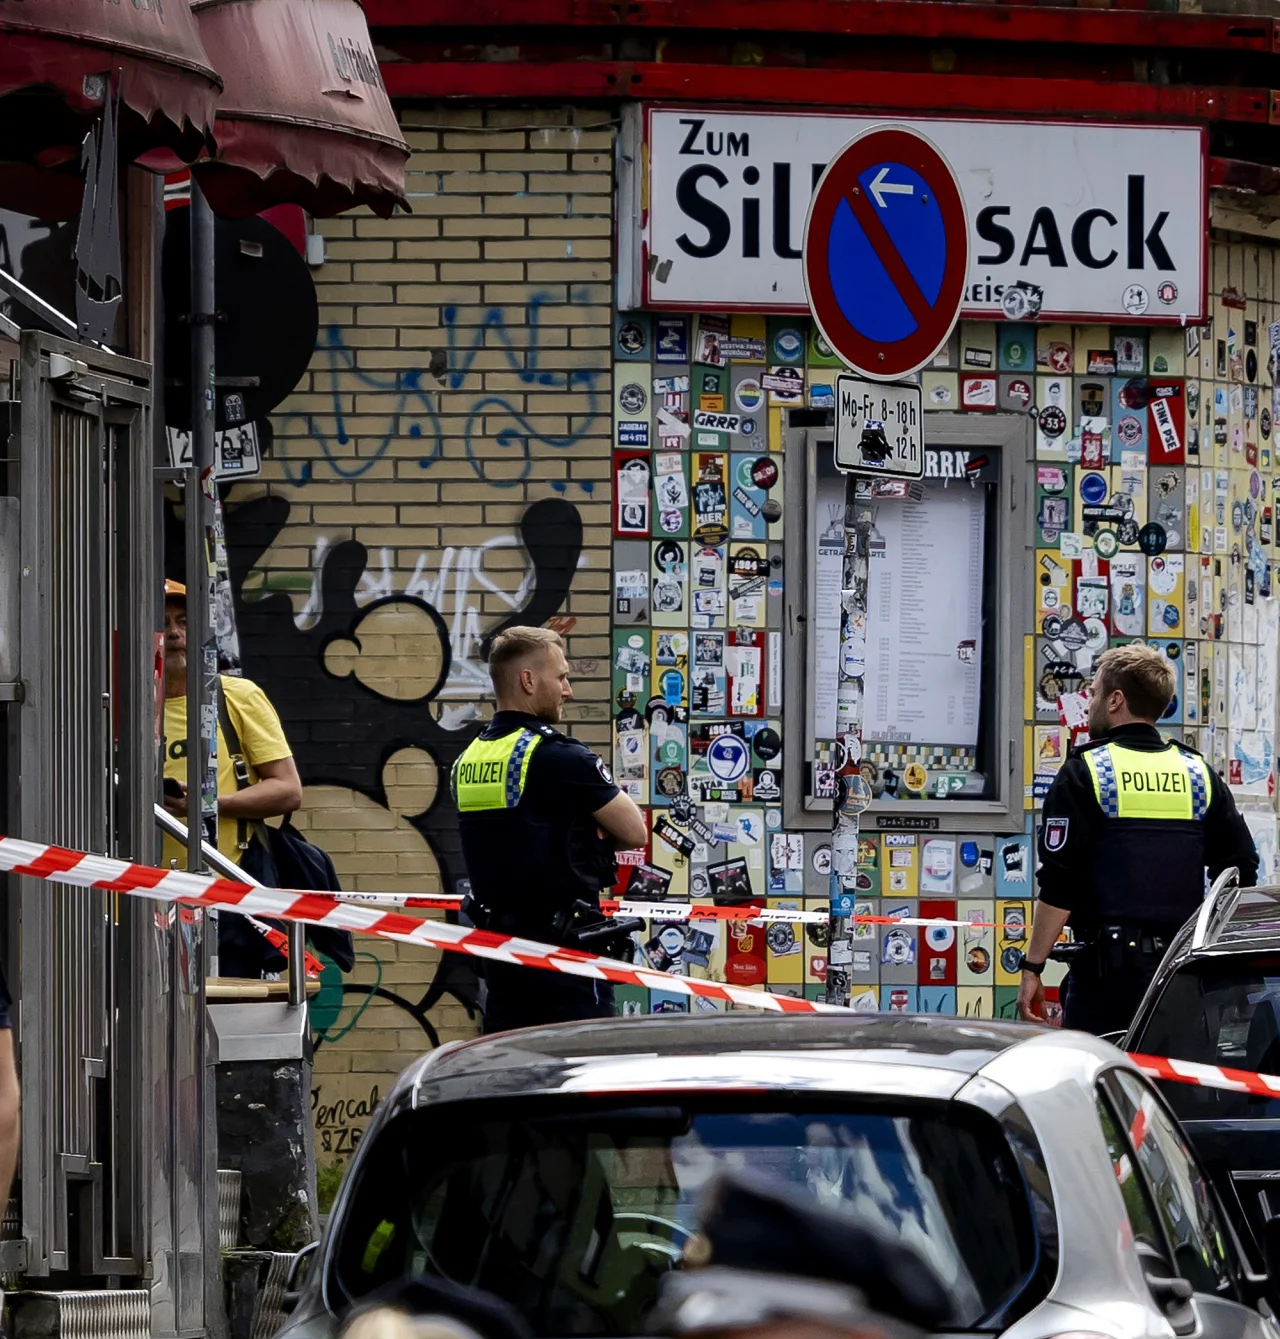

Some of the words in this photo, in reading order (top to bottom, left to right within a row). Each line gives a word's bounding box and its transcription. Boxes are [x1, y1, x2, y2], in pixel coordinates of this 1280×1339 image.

[842, 390, 874, 420] Mo-Fr
[695, 412, 740, 430] GRRR
[1045, 417, 1059, 429] 33
[459, 761, 504, 785] POLIZEI
[1121, 771, 1187, 793] POLIZEI
